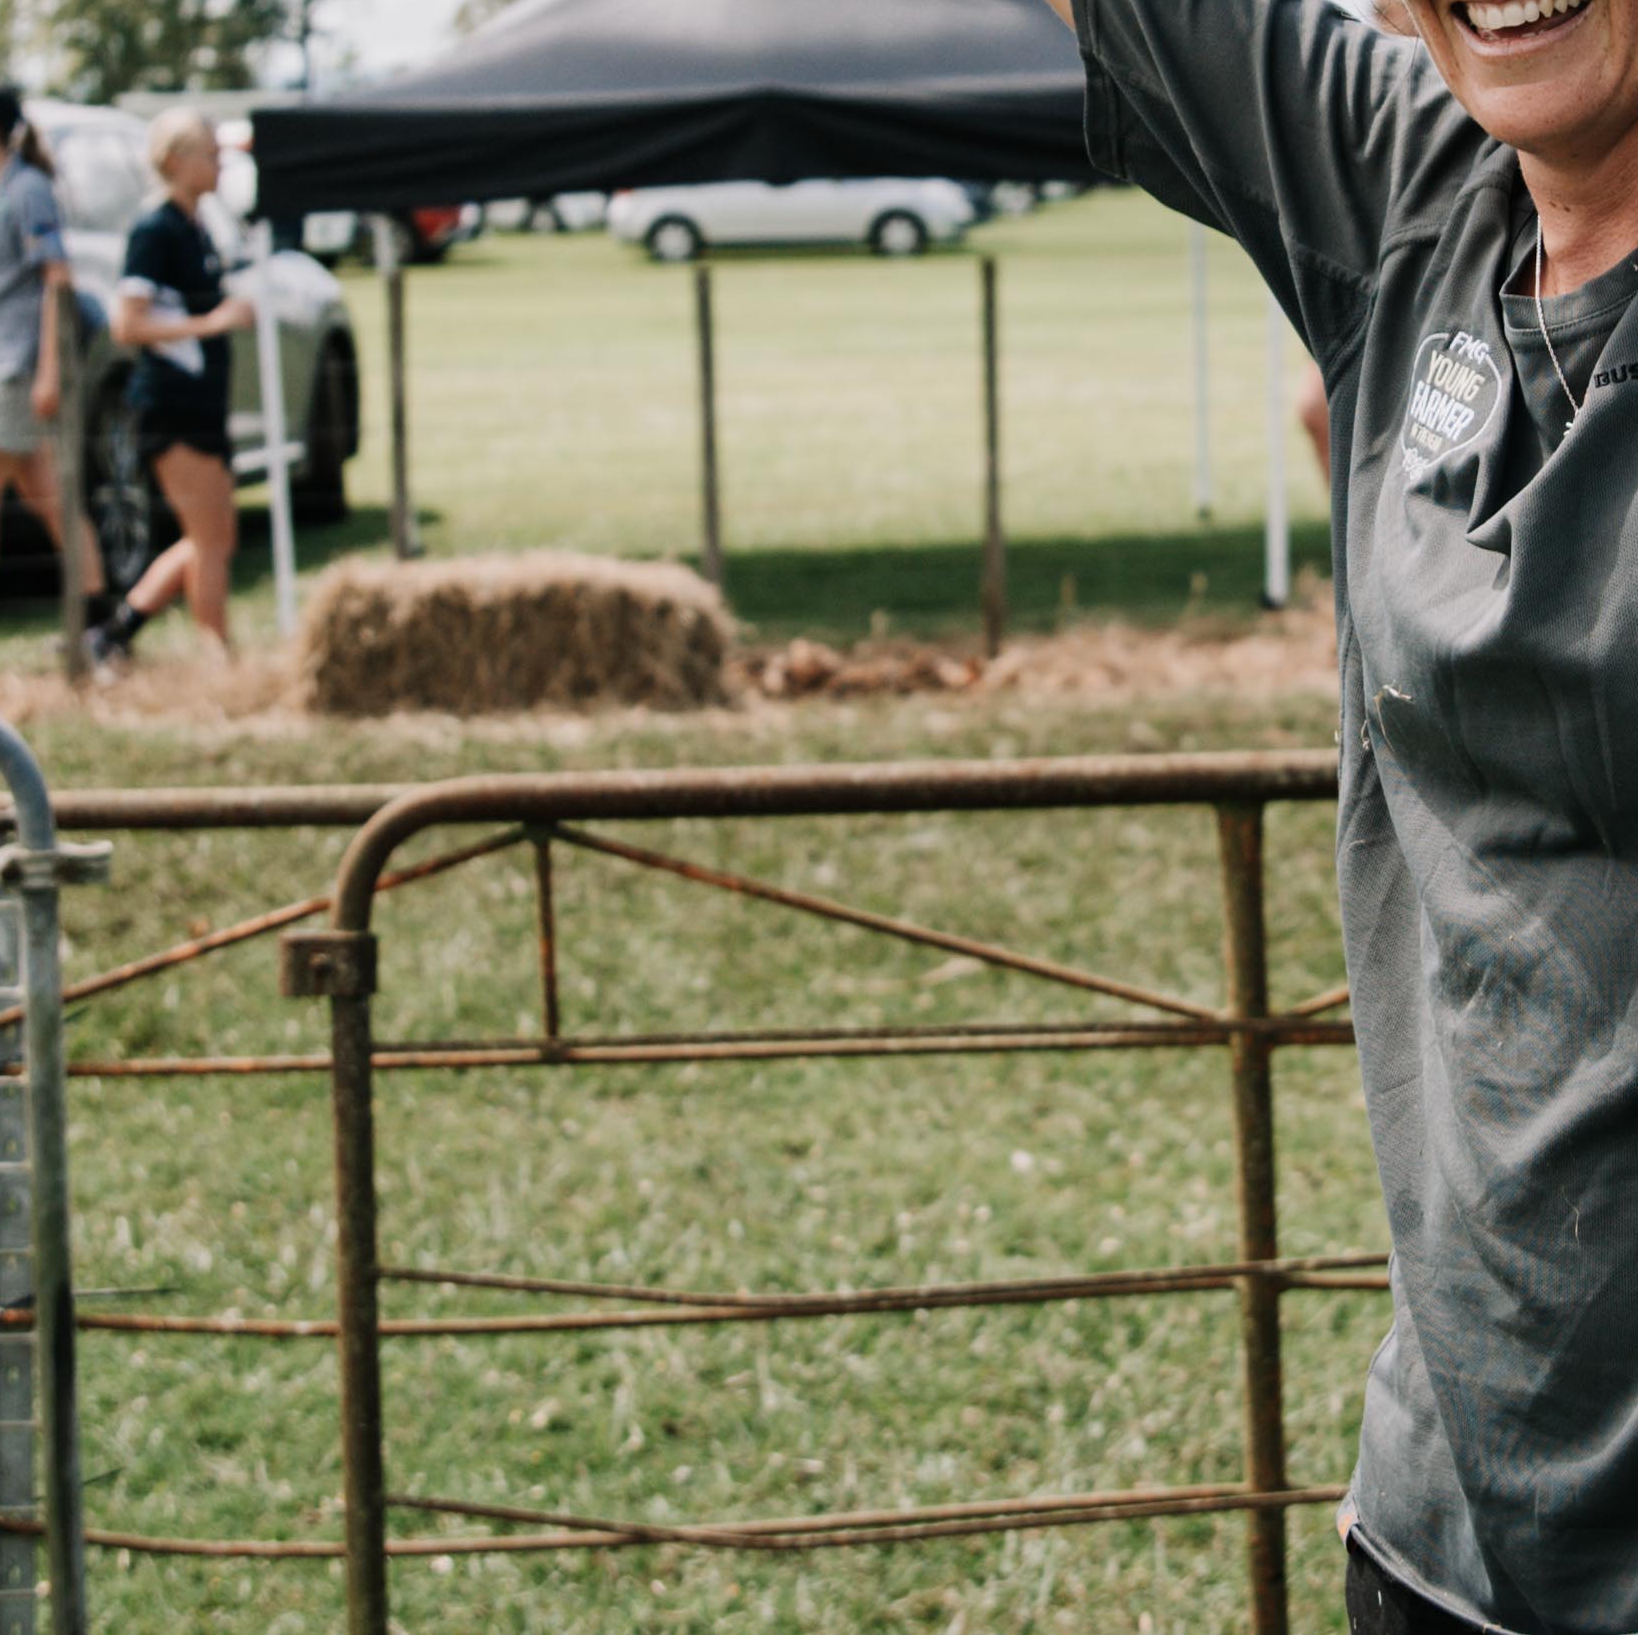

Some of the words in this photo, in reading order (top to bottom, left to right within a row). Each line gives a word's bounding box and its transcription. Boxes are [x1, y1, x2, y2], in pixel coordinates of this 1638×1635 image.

[1449, 331, 1490, 364] FMG
[1426, 350, 1485, 402] YOUNG
[1410, 380, 1475, 441] FARMER
